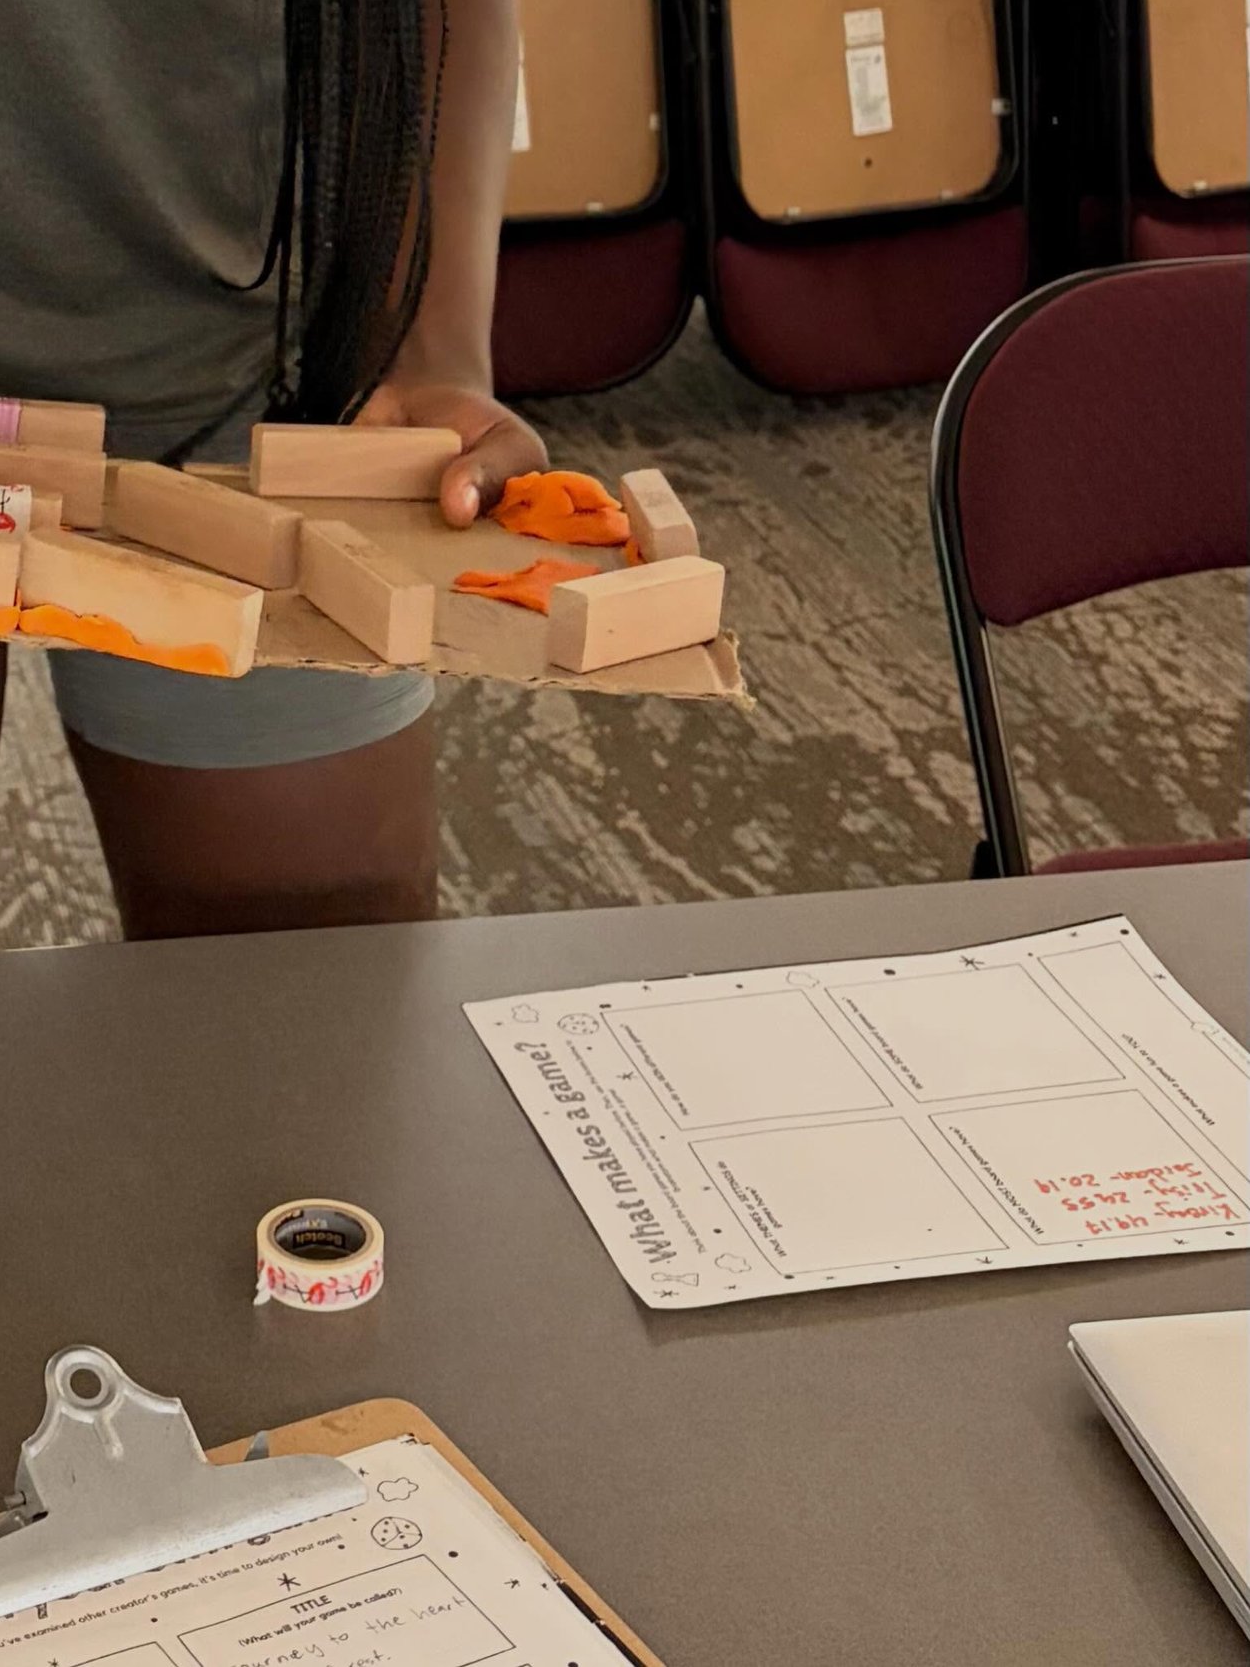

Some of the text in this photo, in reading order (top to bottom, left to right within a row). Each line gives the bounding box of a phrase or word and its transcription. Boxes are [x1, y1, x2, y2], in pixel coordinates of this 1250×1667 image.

[1156, 1066, 1176, 1082] game
[1177, 1088, 1198, 1108] makes
[1195, 1108, 1215, 1126] What
[514, 1042, 677, 1264] What makes a game?
[718, 1161, 727, 1169] do
[722, 1170, 749, 1202] SETTINGS
[949, 1126, 1044, 1234] What do MOST board games have?
[745, 1186, 782, 1228] games have?
[749, 1211, 773, 1238] THEMES
[769, 1239, 787, 1257] What
[23, 1619, 77, 1640] examined
[79, 1609, 107, 1624] other
[110, 1593, 158, 1614] creator's
[160, 1582, 199, 1599] games,
[199, 1574, 217, 1585] it's
[217, 1567, 240, 1580] time
[241, 1562, 254, 1571] to
[255, 1550, 290, 1567] design
[292, 1542, 315, 1556] your
[290, 1594, 332, 1615] TITLE
[238, 1632, 273, 1647] (What
[275, 1624, 293, 1637] will
[293, 1615, 317, 1630] your
[319, 1606, 347, 1621] game
[349, 1600, 362, 1610] be
[328, 1632, 349, 1645] to
[365, 1616, 406, 1634] the
[411, 1595, 468, 1621] heart
